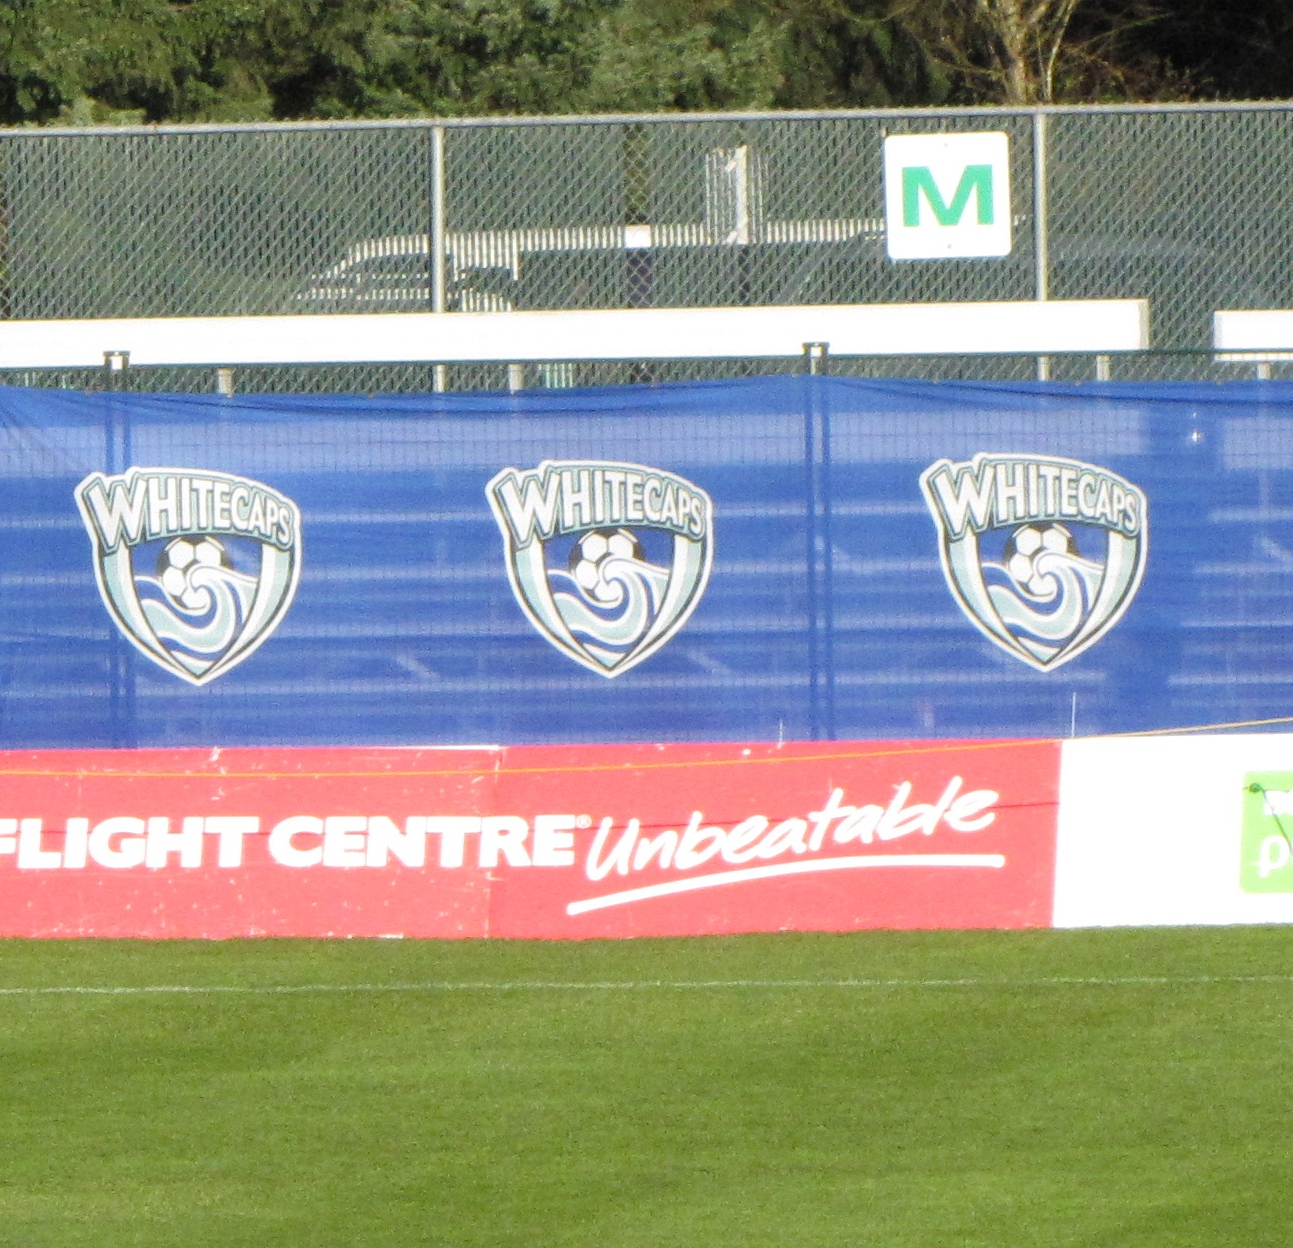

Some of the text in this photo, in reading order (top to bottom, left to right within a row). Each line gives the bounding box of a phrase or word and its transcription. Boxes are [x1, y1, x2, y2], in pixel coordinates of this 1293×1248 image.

[902, 164, 994, 227] M
[91, 473, 293, 549] WHITECAPS
[499, 467, 705, 544] WHITECAPS
[931, 460, 1139, 538] WHITECAPS
[269, 812, 574, 868] CENTRE
[584, 774, 998, 882] Unbeatable
